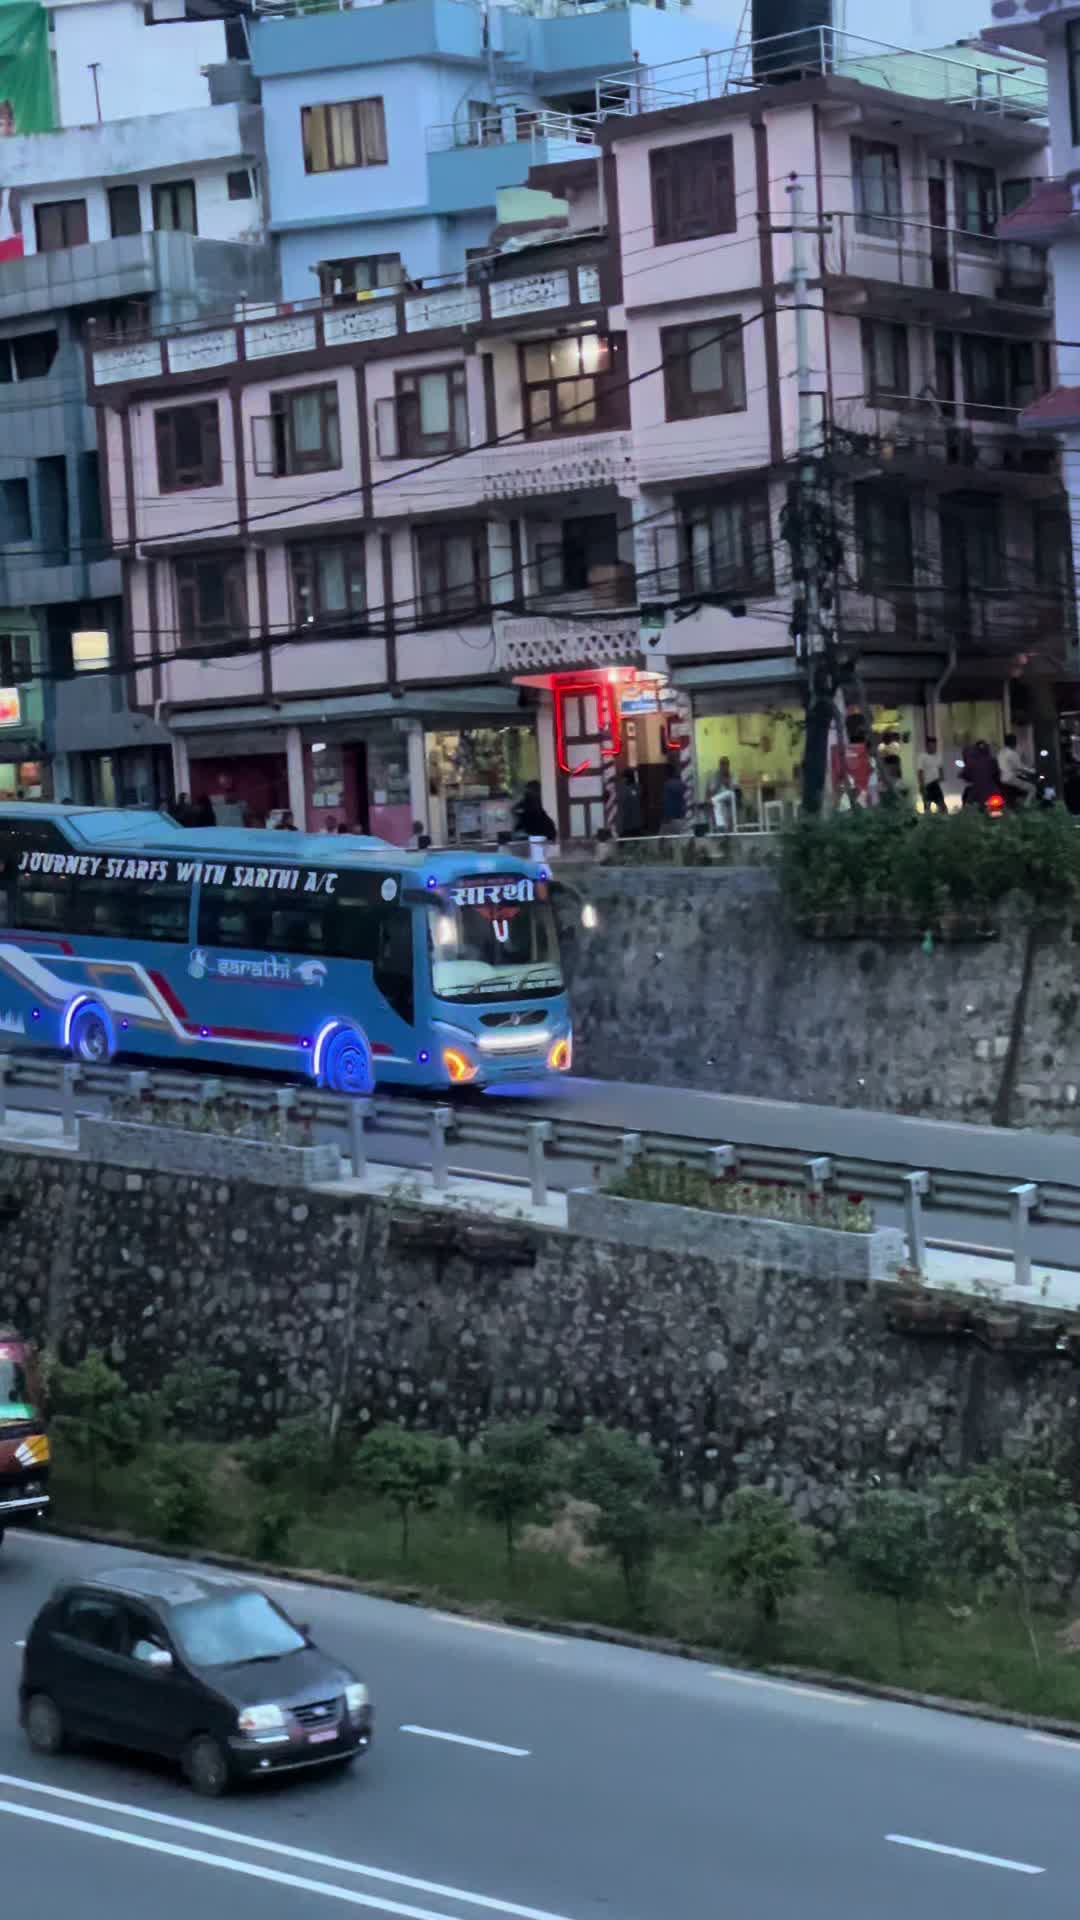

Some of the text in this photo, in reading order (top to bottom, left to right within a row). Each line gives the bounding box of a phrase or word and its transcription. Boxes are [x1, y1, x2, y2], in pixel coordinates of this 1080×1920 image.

[18, 851, 338, 894] JOURNEY STARTS WITH SARTHI A/C
